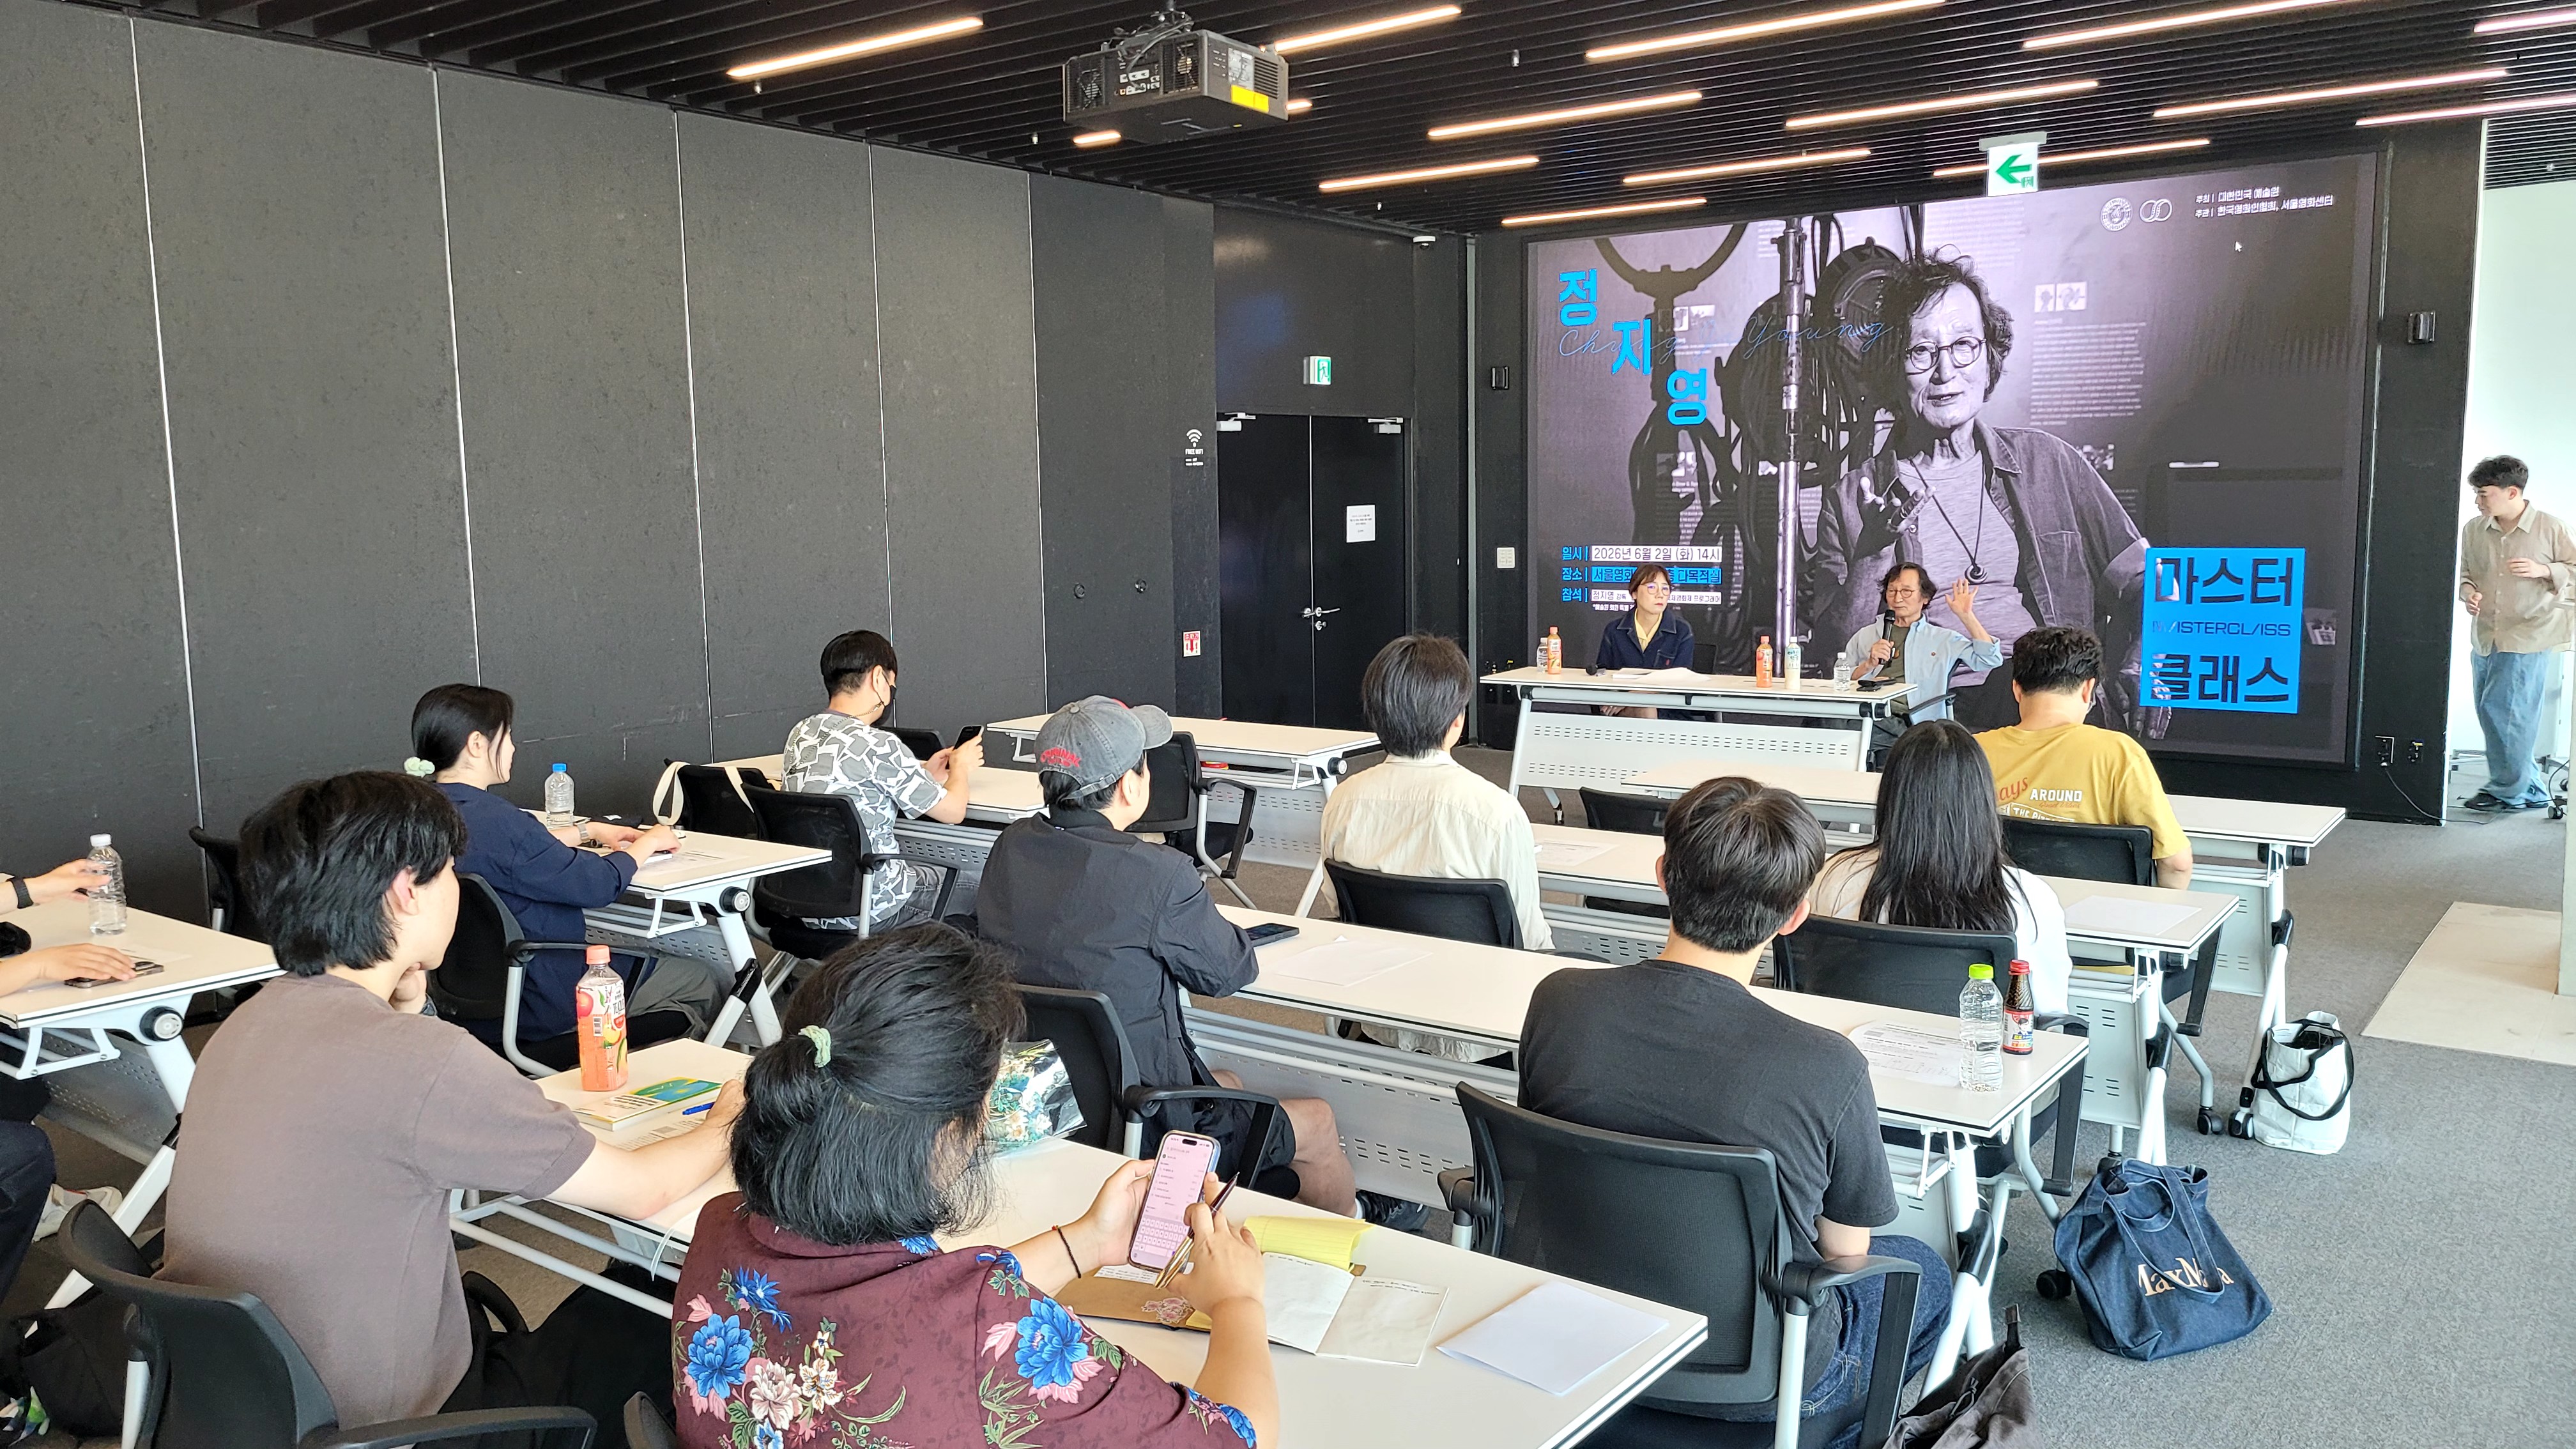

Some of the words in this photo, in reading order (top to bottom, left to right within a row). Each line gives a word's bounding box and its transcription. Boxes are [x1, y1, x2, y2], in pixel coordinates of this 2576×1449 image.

[2218, 188, 2252, 203] 대한민국
[2280, 194, 2333, 210] 서울영화센터
[1744, 316, 1894, 359] Young
[1561, 546, 1583, 560] 일시
[1594, 548, 1631, 560] 2026년
[1635, 548, 1652, 560] 6월
[1655, 548, 1672, 560] 2일
[1675, 548, 1693, 561] (화)
[1698, 548, 1719, 560] 14시
[1561, 567, 1583, 582] 장소
[1593, 568, 1633, 581] 서울영화
[1678, 569, 1720, 583] 다목적실
[2154, 557, 2294, 606] 마스터
[1561, 587, 1583, 602] 참석
[1593, 591, 1614, 600] 정지영
[2149, 654, 2289, 703] 클래스
[1998, 777, 2028, 801] ays
[2030, 788, 2083, 802] AROUND
[2012, 807, 2030, 817] THE
